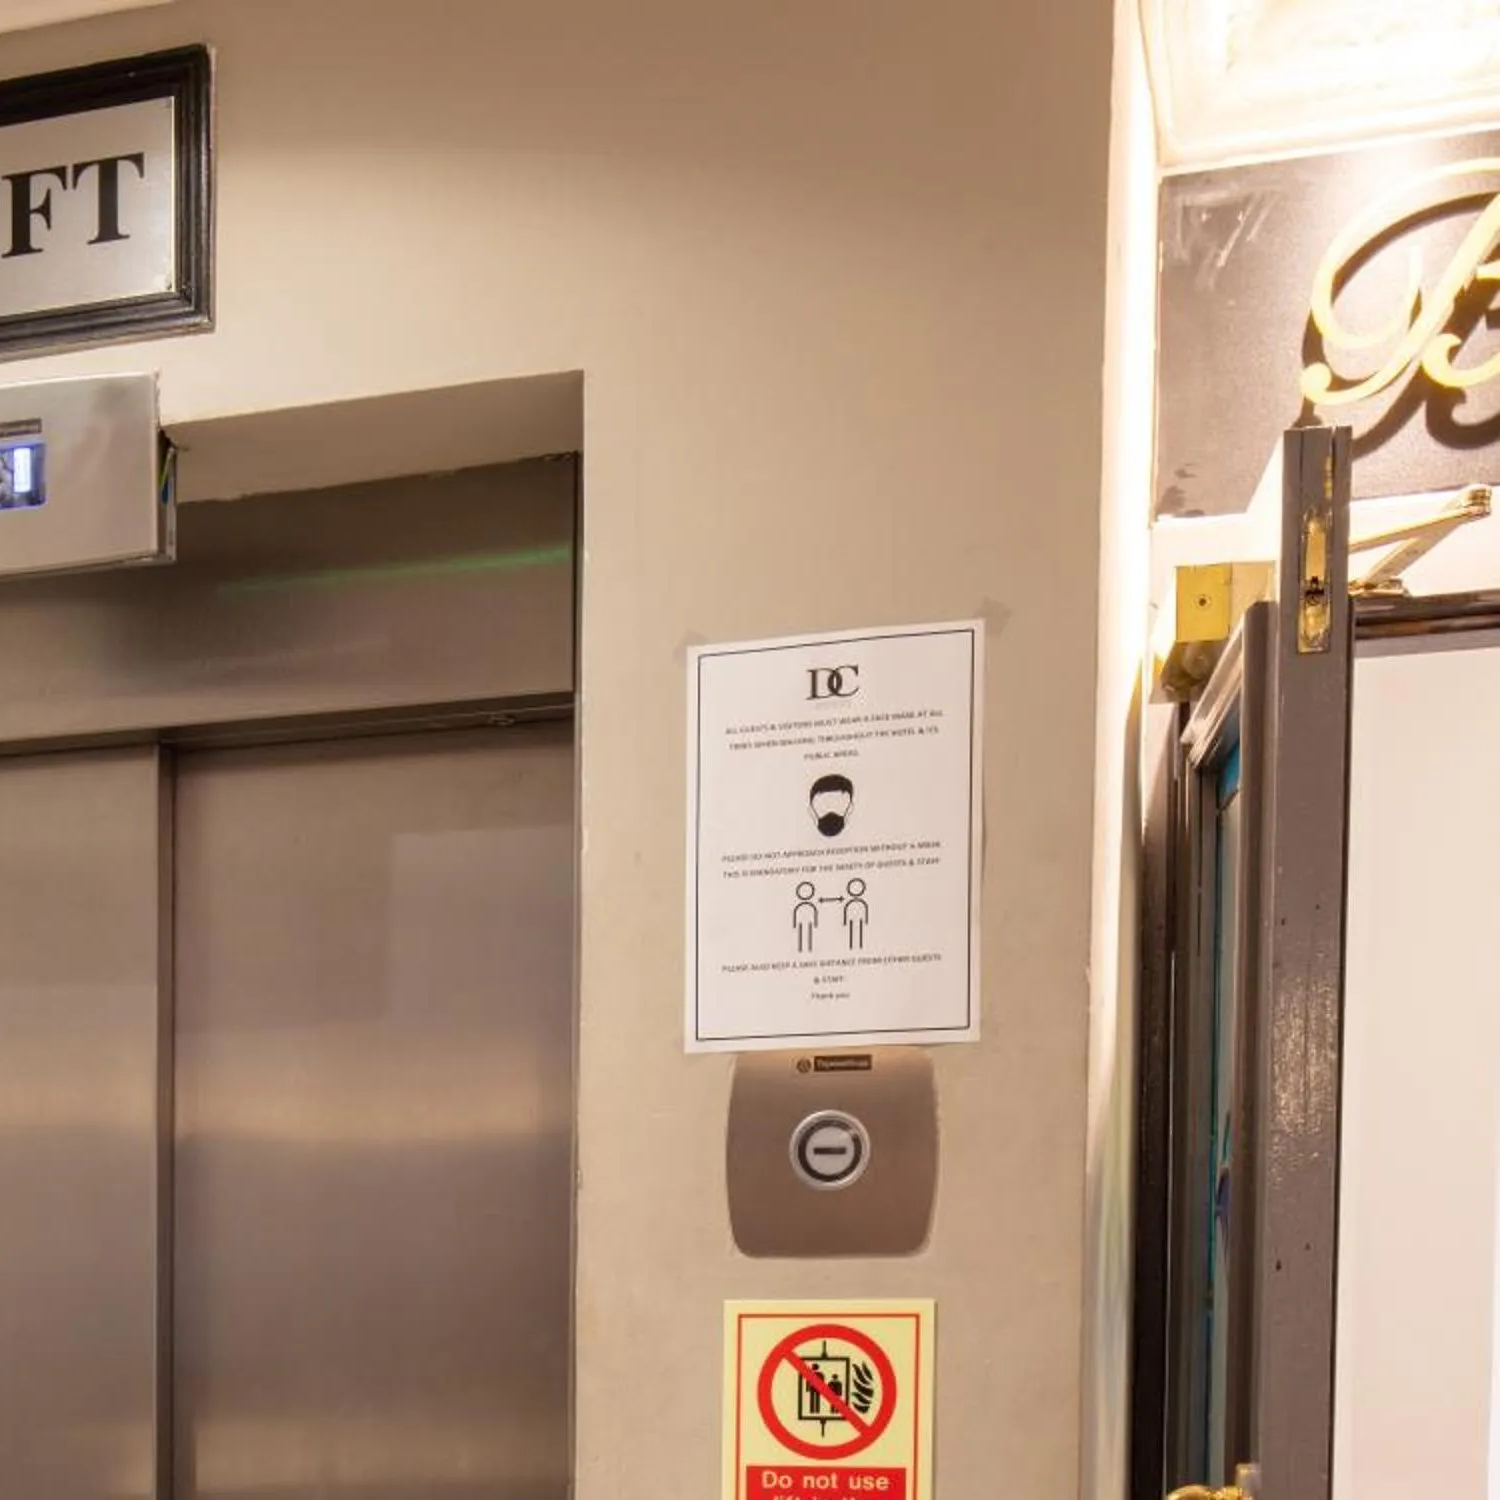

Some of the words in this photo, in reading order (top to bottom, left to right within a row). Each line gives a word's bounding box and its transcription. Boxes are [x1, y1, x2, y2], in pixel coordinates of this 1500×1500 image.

[806, 664, 860, 701] DC
[761, 1470, 793, 1489] Do
[803, 1472, 838, 1490] not
[849, 1476, 890, 1491] use
